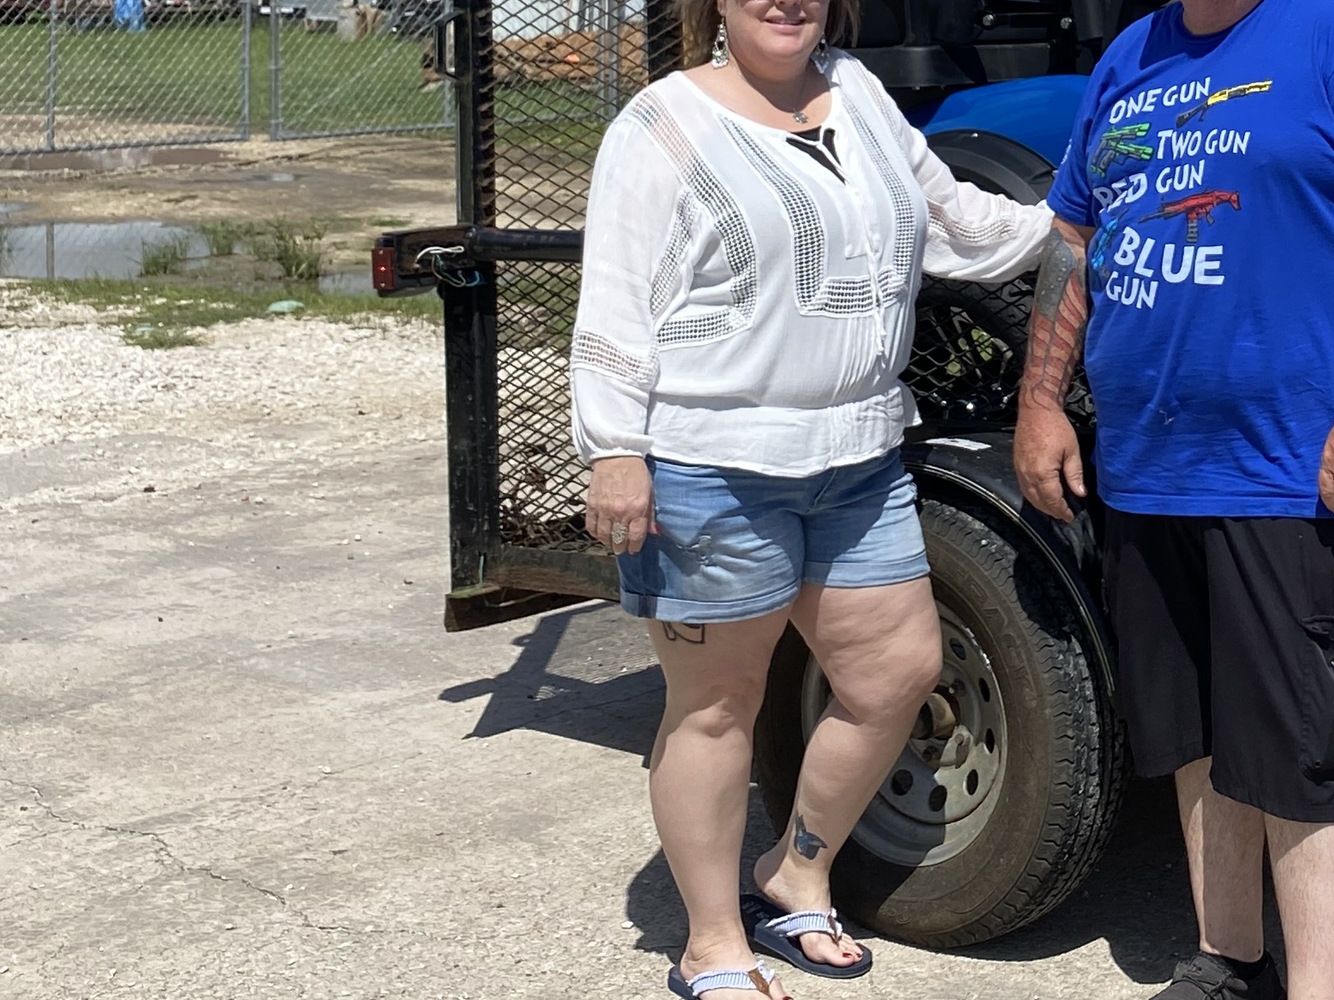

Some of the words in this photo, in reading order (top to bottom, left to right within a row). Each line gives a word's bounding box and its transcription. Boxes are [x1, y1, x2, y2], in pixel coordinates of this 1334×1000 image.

[1108, 86, 1163, 125] ONE
[1162, 76, 1212, 107] GUN
[1156, 130, 1201, 161] TWO
[1204, 130, 1251, 156] GUN
[1092, 172, 1149, 215] RED
[1155, 160, 1206, 195] GUN
[1112, 226, 1226, 285] BLUE
[1105, 271, 1160, 310] GUN
